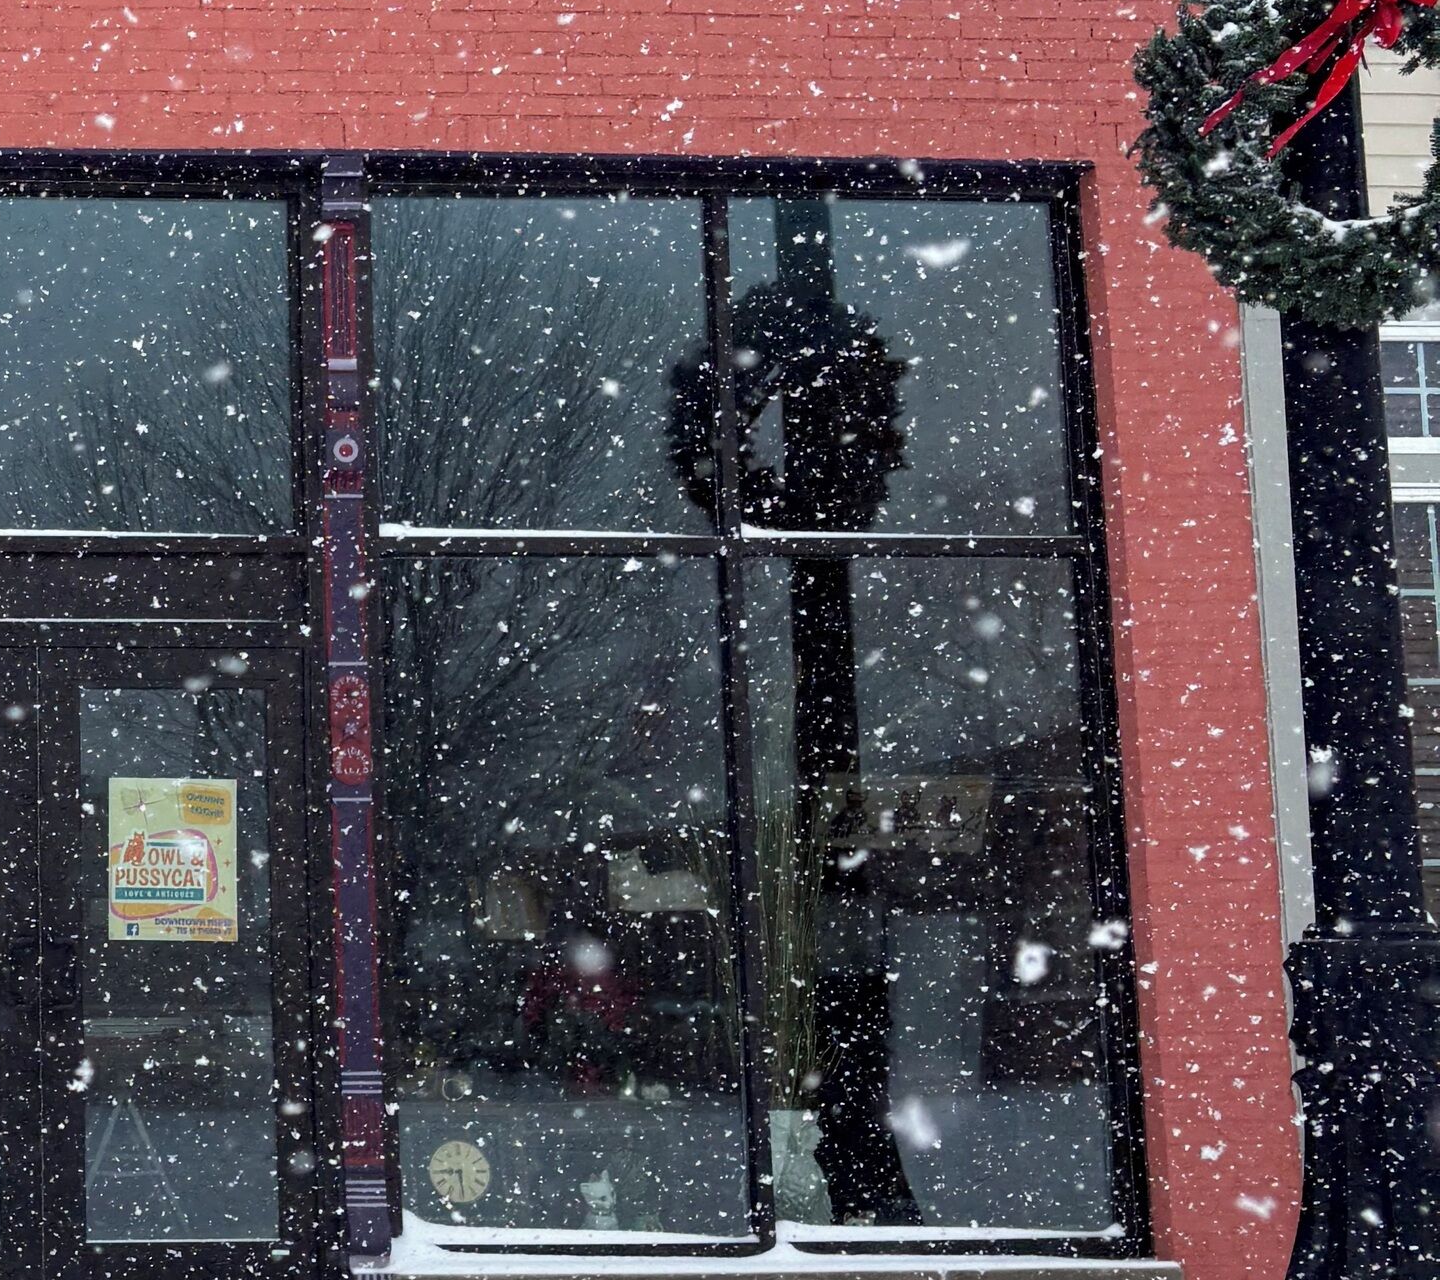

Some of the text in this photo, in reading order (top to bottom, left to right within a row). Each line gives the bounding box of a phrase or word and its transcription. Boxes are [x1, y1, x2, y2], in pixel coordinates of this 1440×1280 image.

[148, 847, 204, 867] OWL &
[115, 868, 201, 887] PUSSYCAT
